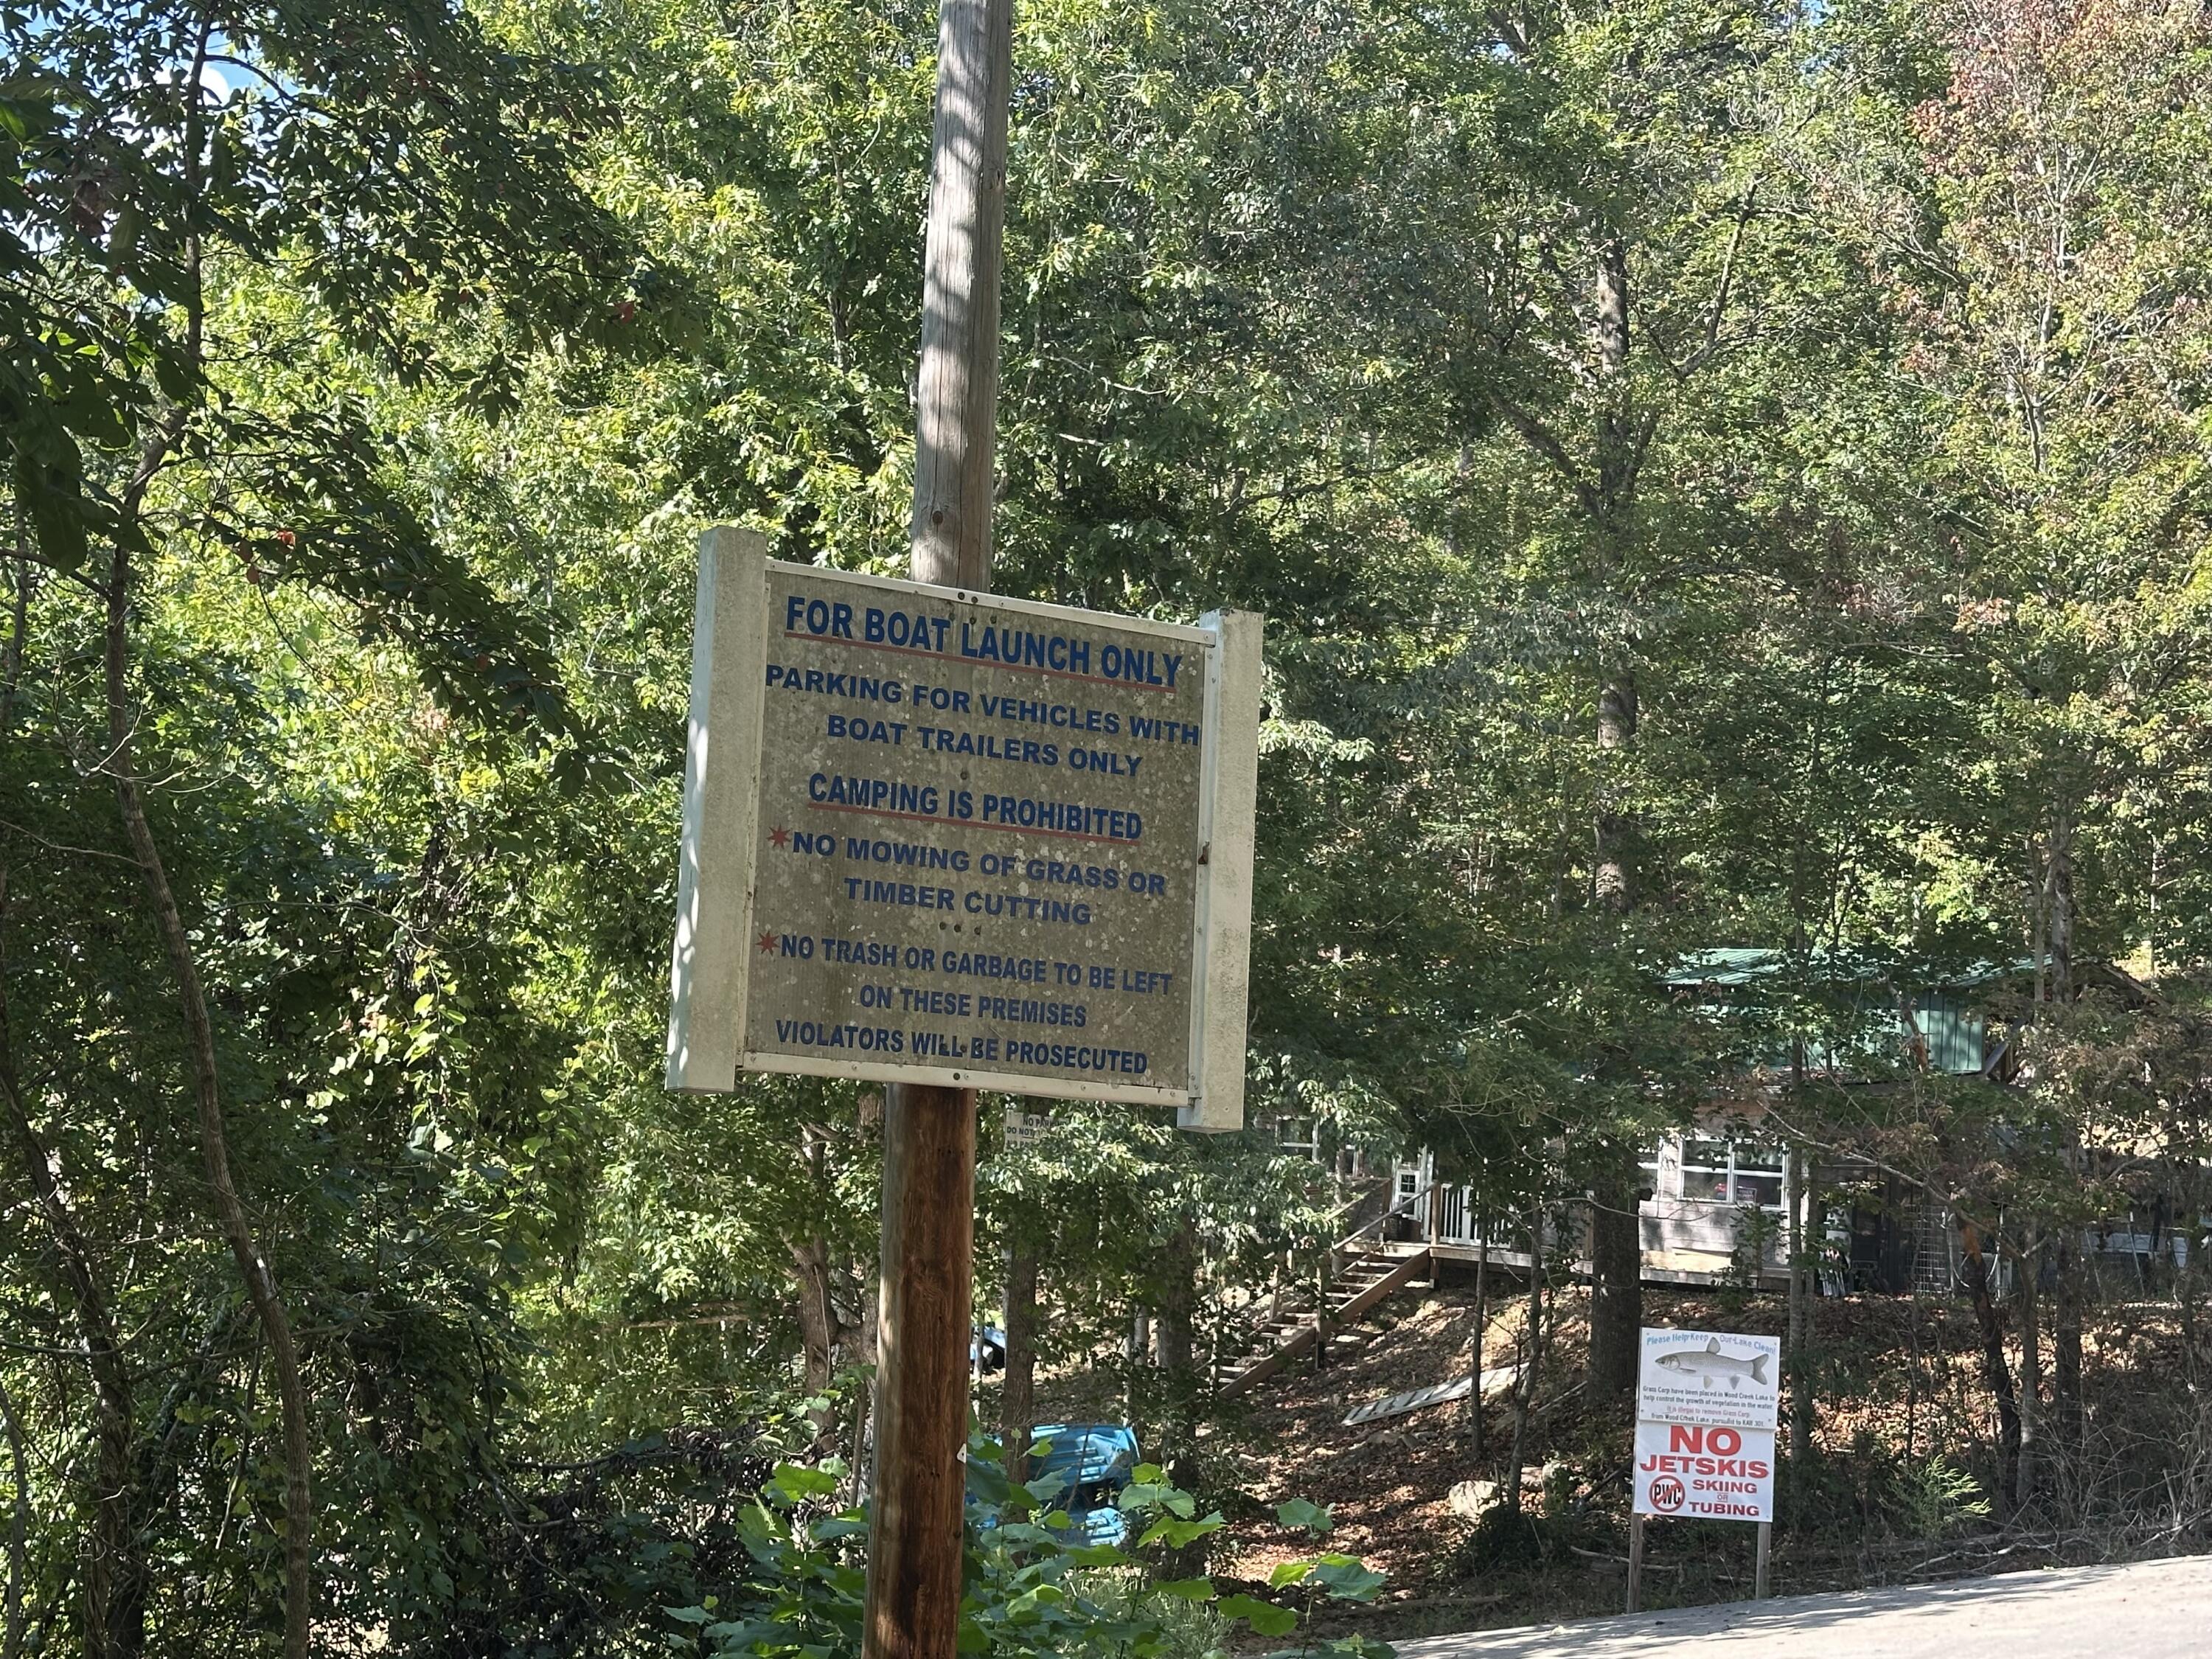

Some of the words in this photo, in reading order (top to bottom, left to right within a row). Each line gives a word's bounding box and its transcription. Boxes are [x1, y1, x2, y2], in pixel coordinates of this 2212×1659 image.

[786, 596, 854, 639] FOR
[864, 608, 952, 652] BOAT
[960, 624, 1091, 674] LAUNCH
[1100, 644, 1183, 687] ONLY
[765, 664, 902, 703] PARKING
[912, 684, 971, 714] FOR
[980, 695, 1121, 736] VEHICLES
[1129, 716, 1201, 745] WITH
[827, 714, 907, 744] BOAT
[917, 726, 1059, 767] TRAILERS
[1068, 748, 1142, 777] ONLY
[809, 773, 939, 815] CAMPING
[948, 790, 973, 819] IS
[982, 793, 1142, 840] PROHIBITED
[793, 832, 836, 856] NO
[846, 838, 970, 872] MOWING
[979, 853, 1017, 876] OF
[1026, 860, 1119, 890] GRASS
[1127, 871, 1166, 895] OR
[844, 877, 955, 910] TIMBER
[964, 892, 1091, 926] CUTTING
[781, 935, 814, 959] NO
[821, 937, 897, 968] TRASH
[905, 947, 935, 970] OR
[942, 950, 1046, 983] GARBAGE
[1054, 962, 1082, 986] TO
[1089, 966, 1115, 990] BE
[1121, 970, 1172, 995] LEFT
[860, 985, 891, 1009] ON
[900, 987, 970, 1017] THESE
[978, 996, 1087, 1028] PREMISES
[776, 1020, 904, 1053] VIOLATORS
[911, 1032, 962, 1058] WILL
[970, 1037, 998, 1061] BE
[1005, 1040, 1148, 1075] PROSECUTED
[1007, 1126, 1017, 1134] DO
[1019, 1127, 1034, 1135] NOT
[1023, 1118, 1034, 1127] NO
[1646, 1335, 1671, 1345] Please
[1690, 1332, 1708, 1342] Keep
[1669, 1425, 1742, 1456] NO
[1639, 1455, 1769, 1479] JETSKIS
[1692, 1479, 1758, 1494] SKIING
[1654, 1484, 1681, 1505] PWC
[1688, 1501, 1760, 1517] TUBING
